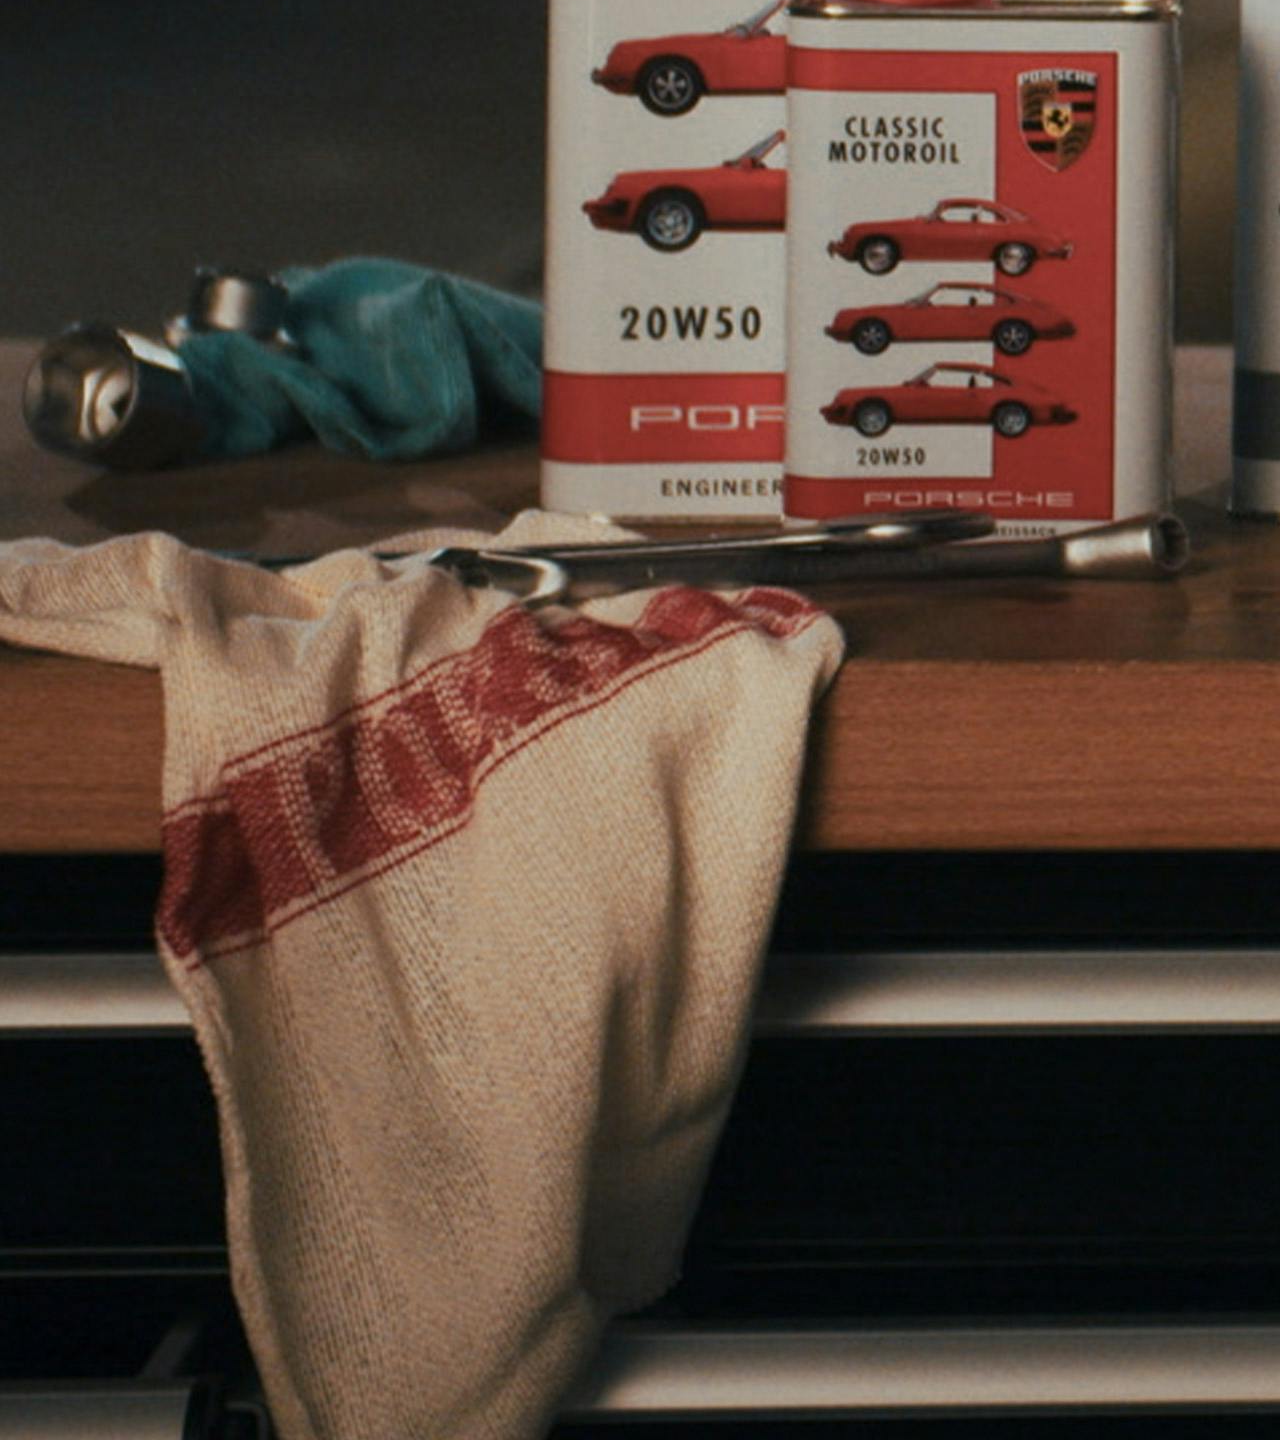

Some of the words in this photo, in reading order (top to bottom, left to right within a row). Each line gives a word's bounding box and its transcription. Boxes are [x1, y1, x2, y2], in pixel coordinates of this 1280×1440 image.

[844, 116, 944, 140] CLASSIC
[828, 141, 960, 165] MOTOROIL
[619, 306, 762, 341] 20W50
[856, 447, 926, 467] 20W50
[864, 491, 1074, 508] PORSCHE
